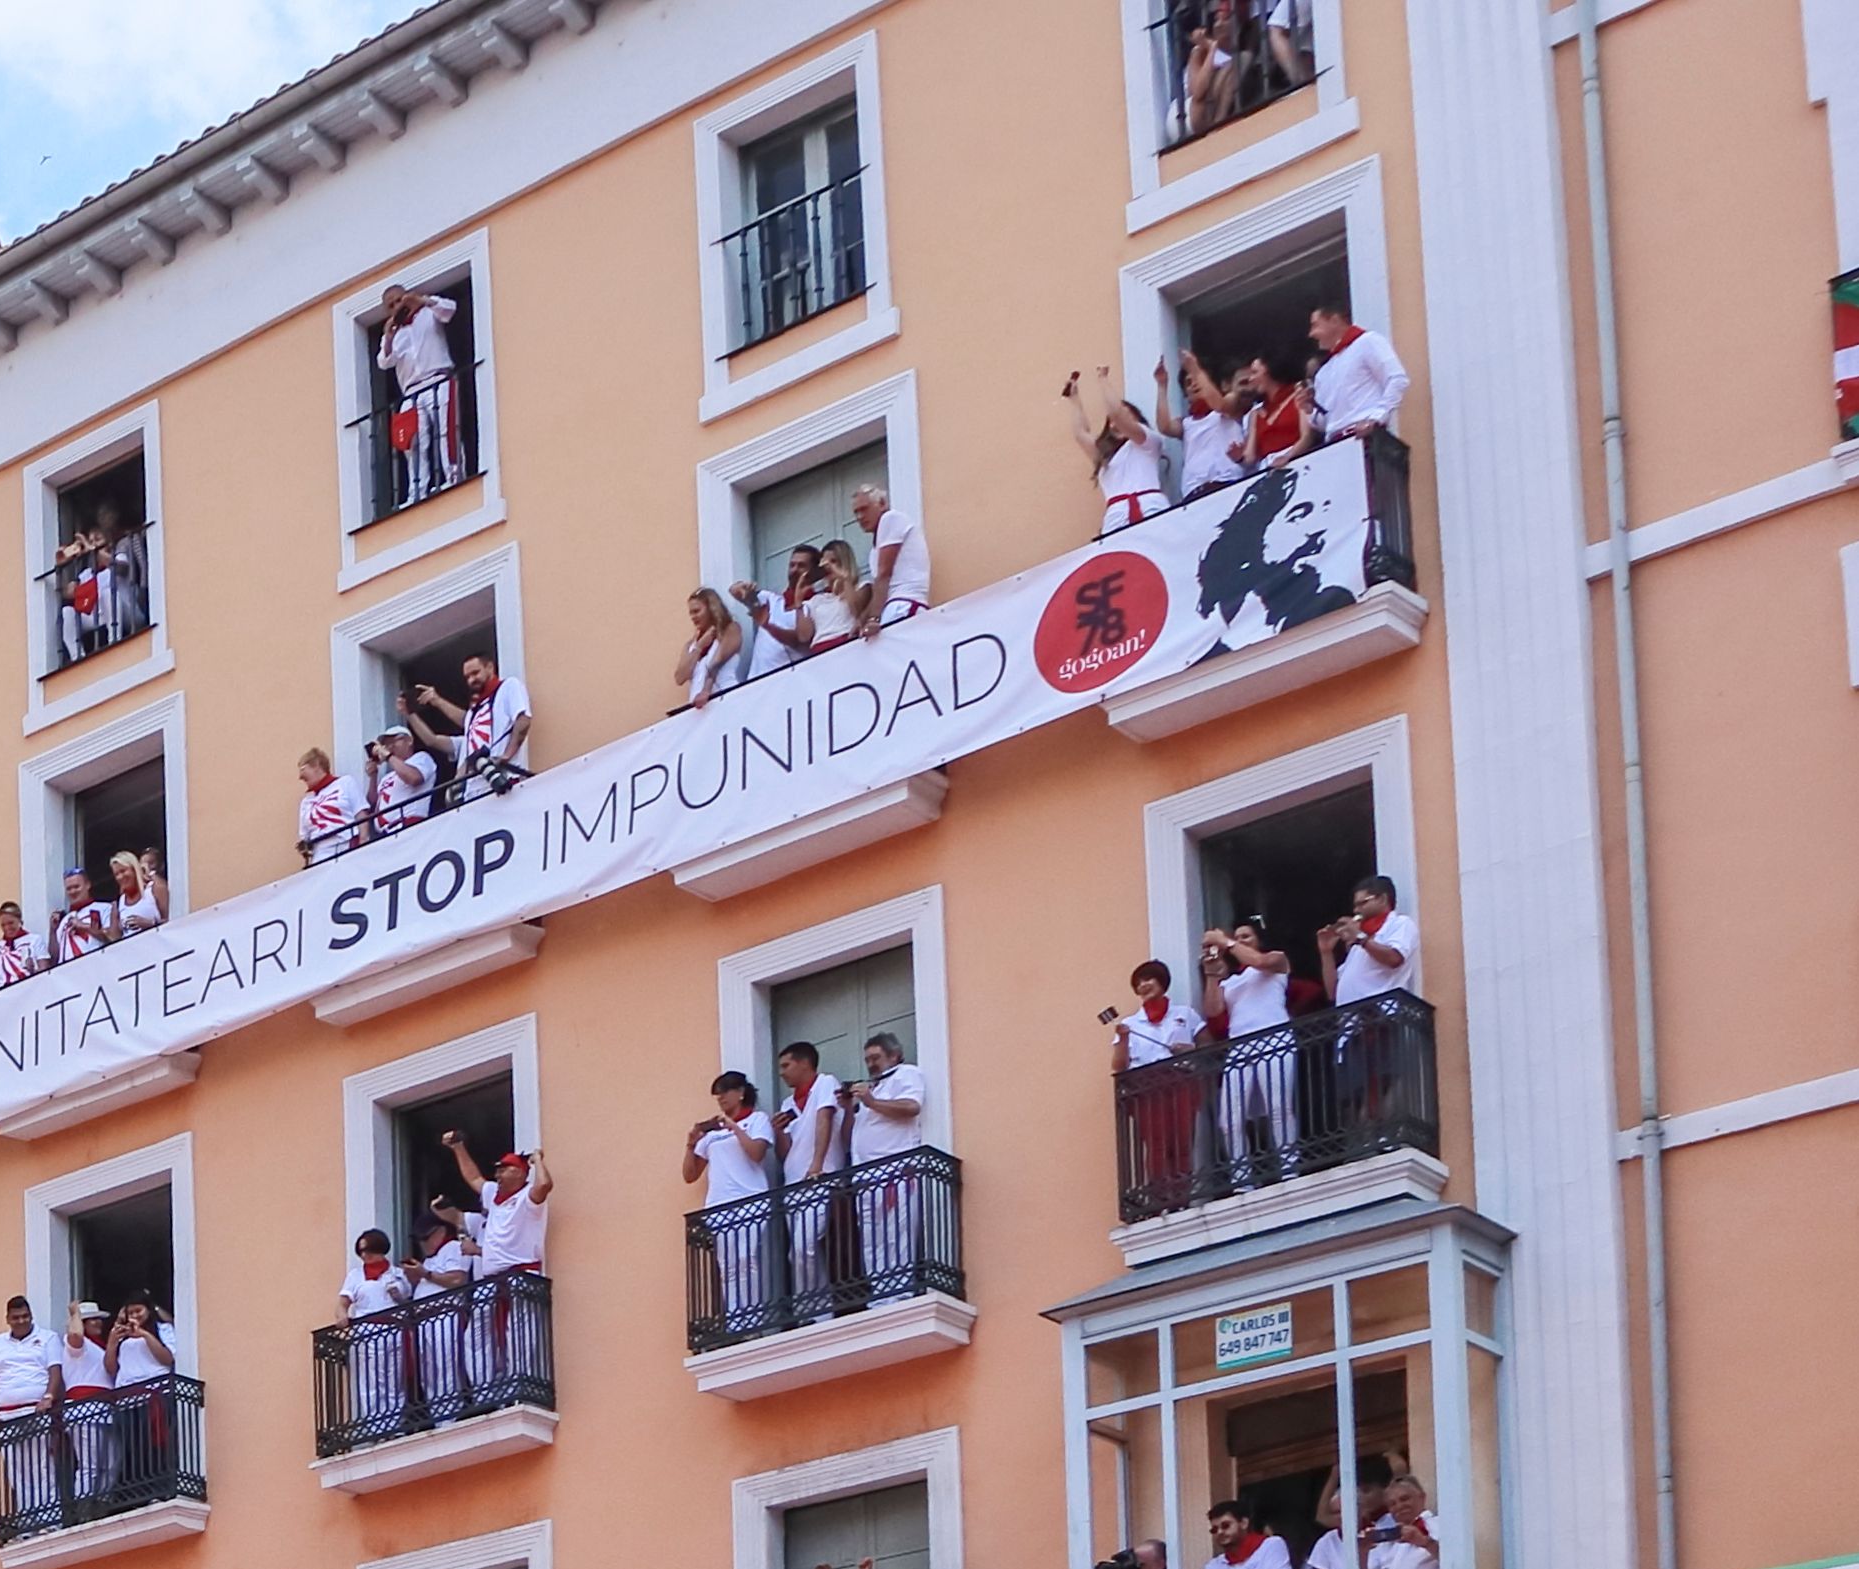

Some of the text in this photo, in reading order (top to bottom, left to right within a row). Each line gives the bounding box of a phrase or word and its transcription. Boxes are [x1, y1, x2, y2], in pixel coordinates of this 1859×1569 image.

[1059, 628, 1147, 681] gogoan!
[328, 828, 515, 951] STOP
[540, 633, 1008, 872] IMPUNIDAD
[1232, 1313, 1275, 1334] CARLOS
[1219, 1339, 1241, 1357] 649
